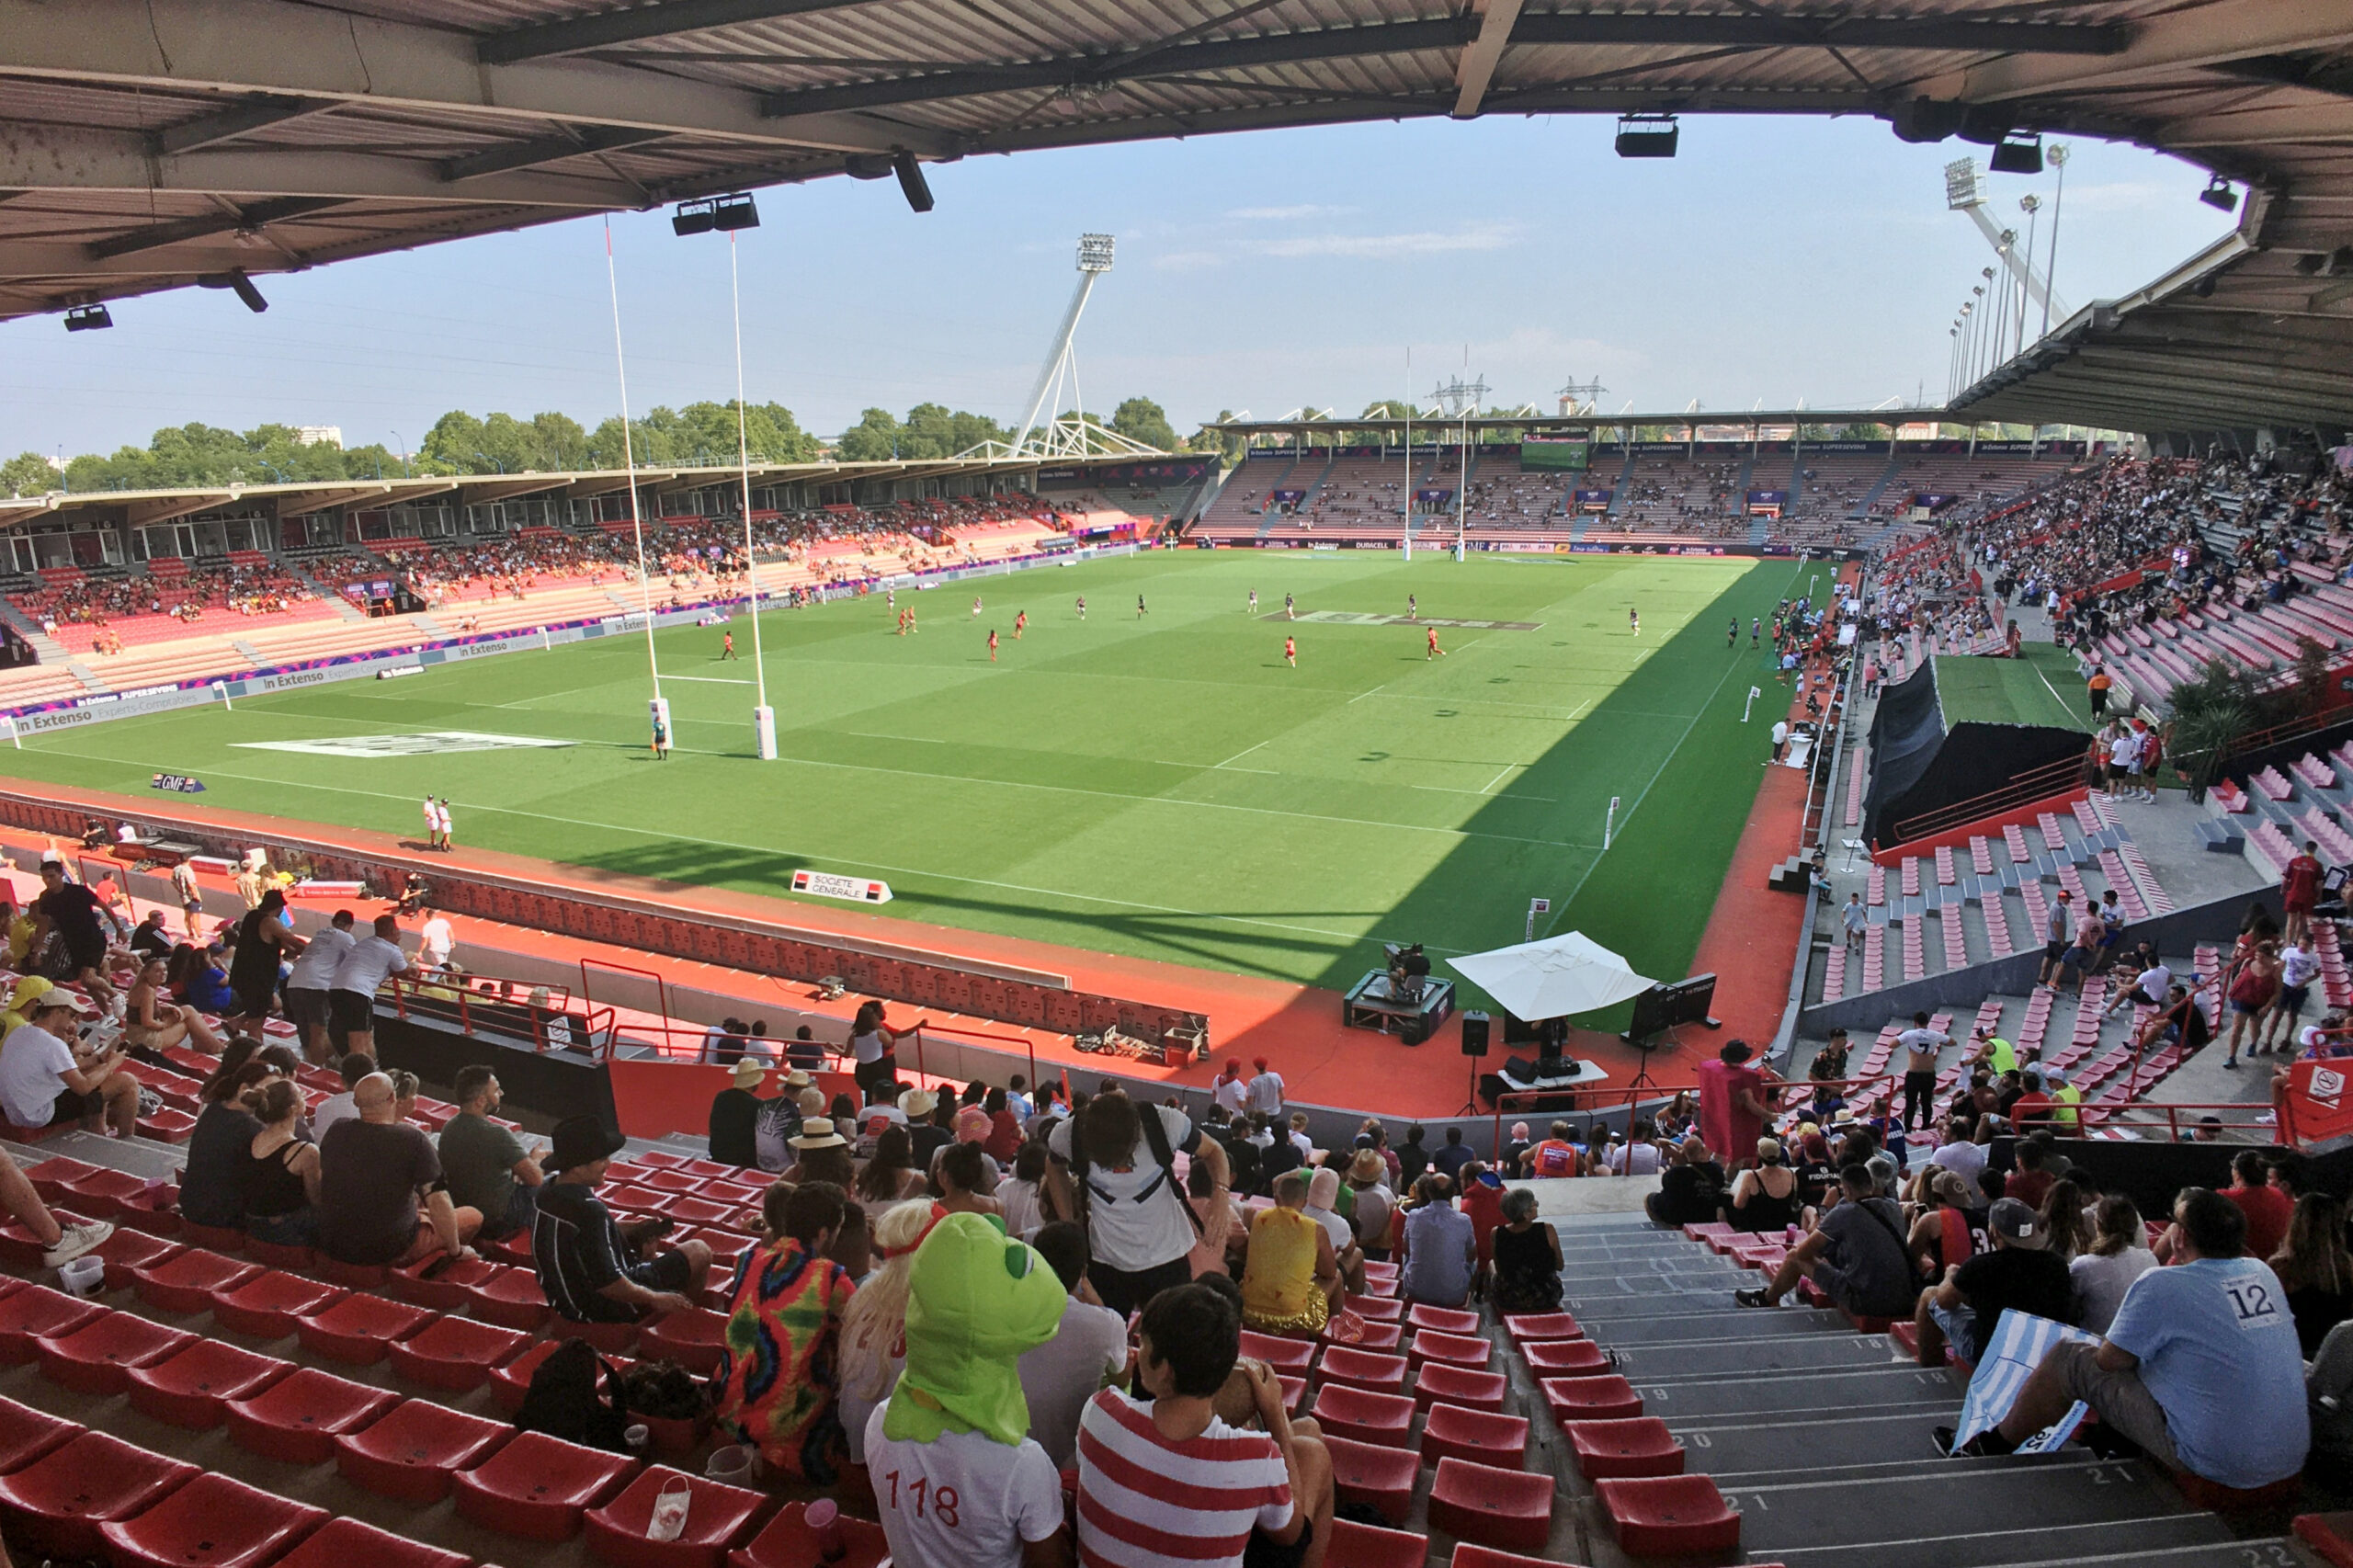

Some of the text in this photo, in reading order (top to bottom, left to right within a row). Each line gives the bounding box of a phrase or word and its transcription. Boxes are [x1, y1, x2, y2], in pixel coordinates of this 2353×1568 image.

[757, 598, 790, 610] Extenso
[460, 642, 507, 657] In Extenso
[264, 679, 275, 689] In
[278, 671, 324, 687] Extenso
[86, 694, 119, 705] Extenso
[120, 684, 178, 700] SUPERSEVENS
[16, 720, 30, 733] In
[33, 710, 92, 729] Extenso
[162, 775, 186, 791] GMF
[813, 885, 861, 898] GENERALE
[2227, 1284, 2278, 1319] 12
[1852, 1338, 1883, 1349] 18
[1915, 1372, 1949, 1385] 19
[1636, 1388, 1669, 1400] 19
[1672, 1433, 1712, 1449] 20
[2086, 1466, 2134, 1485] 21
[886, 1470, 959, 1528] 118
[1724, 1494, 1768, 1513] 21
[2241, 1545, 2296, 1568] 22
